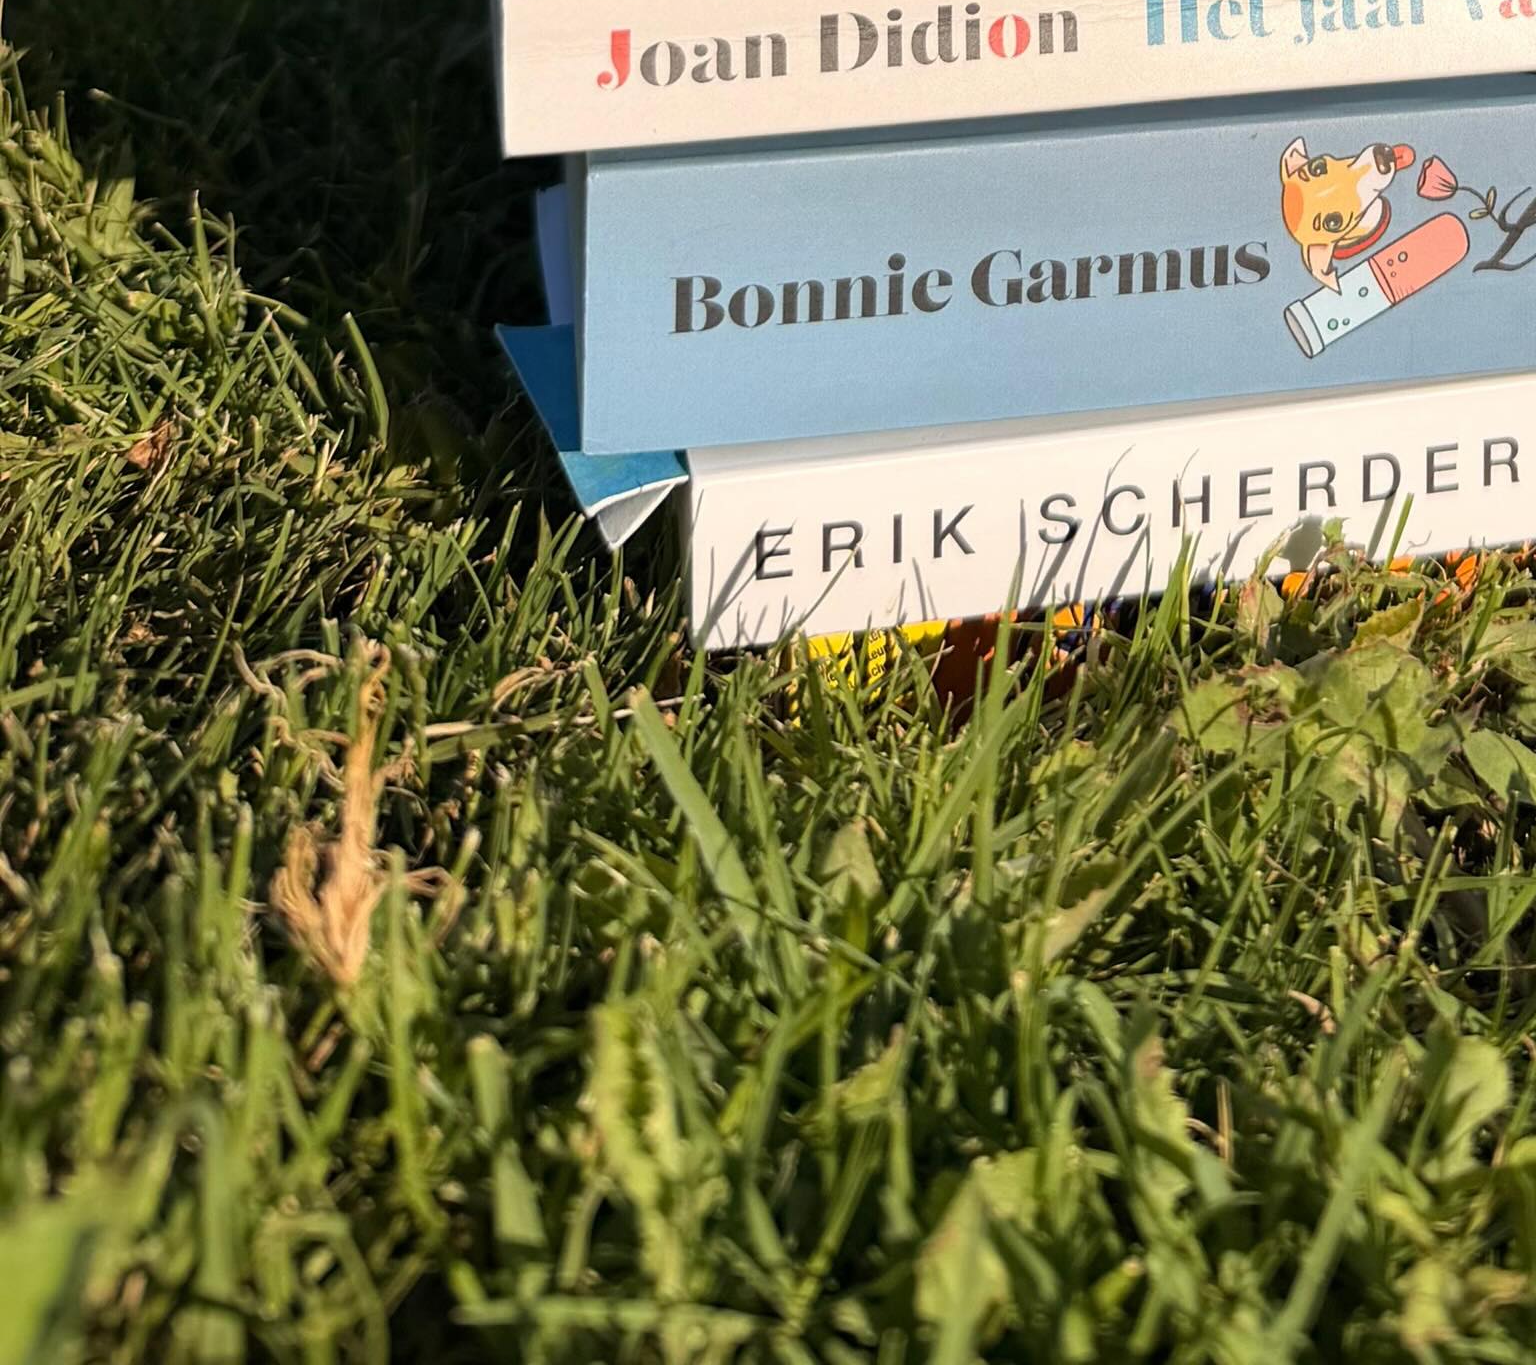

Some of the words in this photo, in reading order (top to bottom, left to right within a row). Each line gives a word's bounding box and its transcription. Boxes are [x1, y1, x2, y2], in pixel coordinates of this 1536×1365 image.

[597, 29, 788, 91] Joan
[819, 2, 1078, 73] Didion
[668, 252, 953, 334] Bonnie
[970, 240, 1272, 307] Garmus
[754, 504, 976, 581] ERIK
[1036, 435, 1521, 545] SCHERDER
